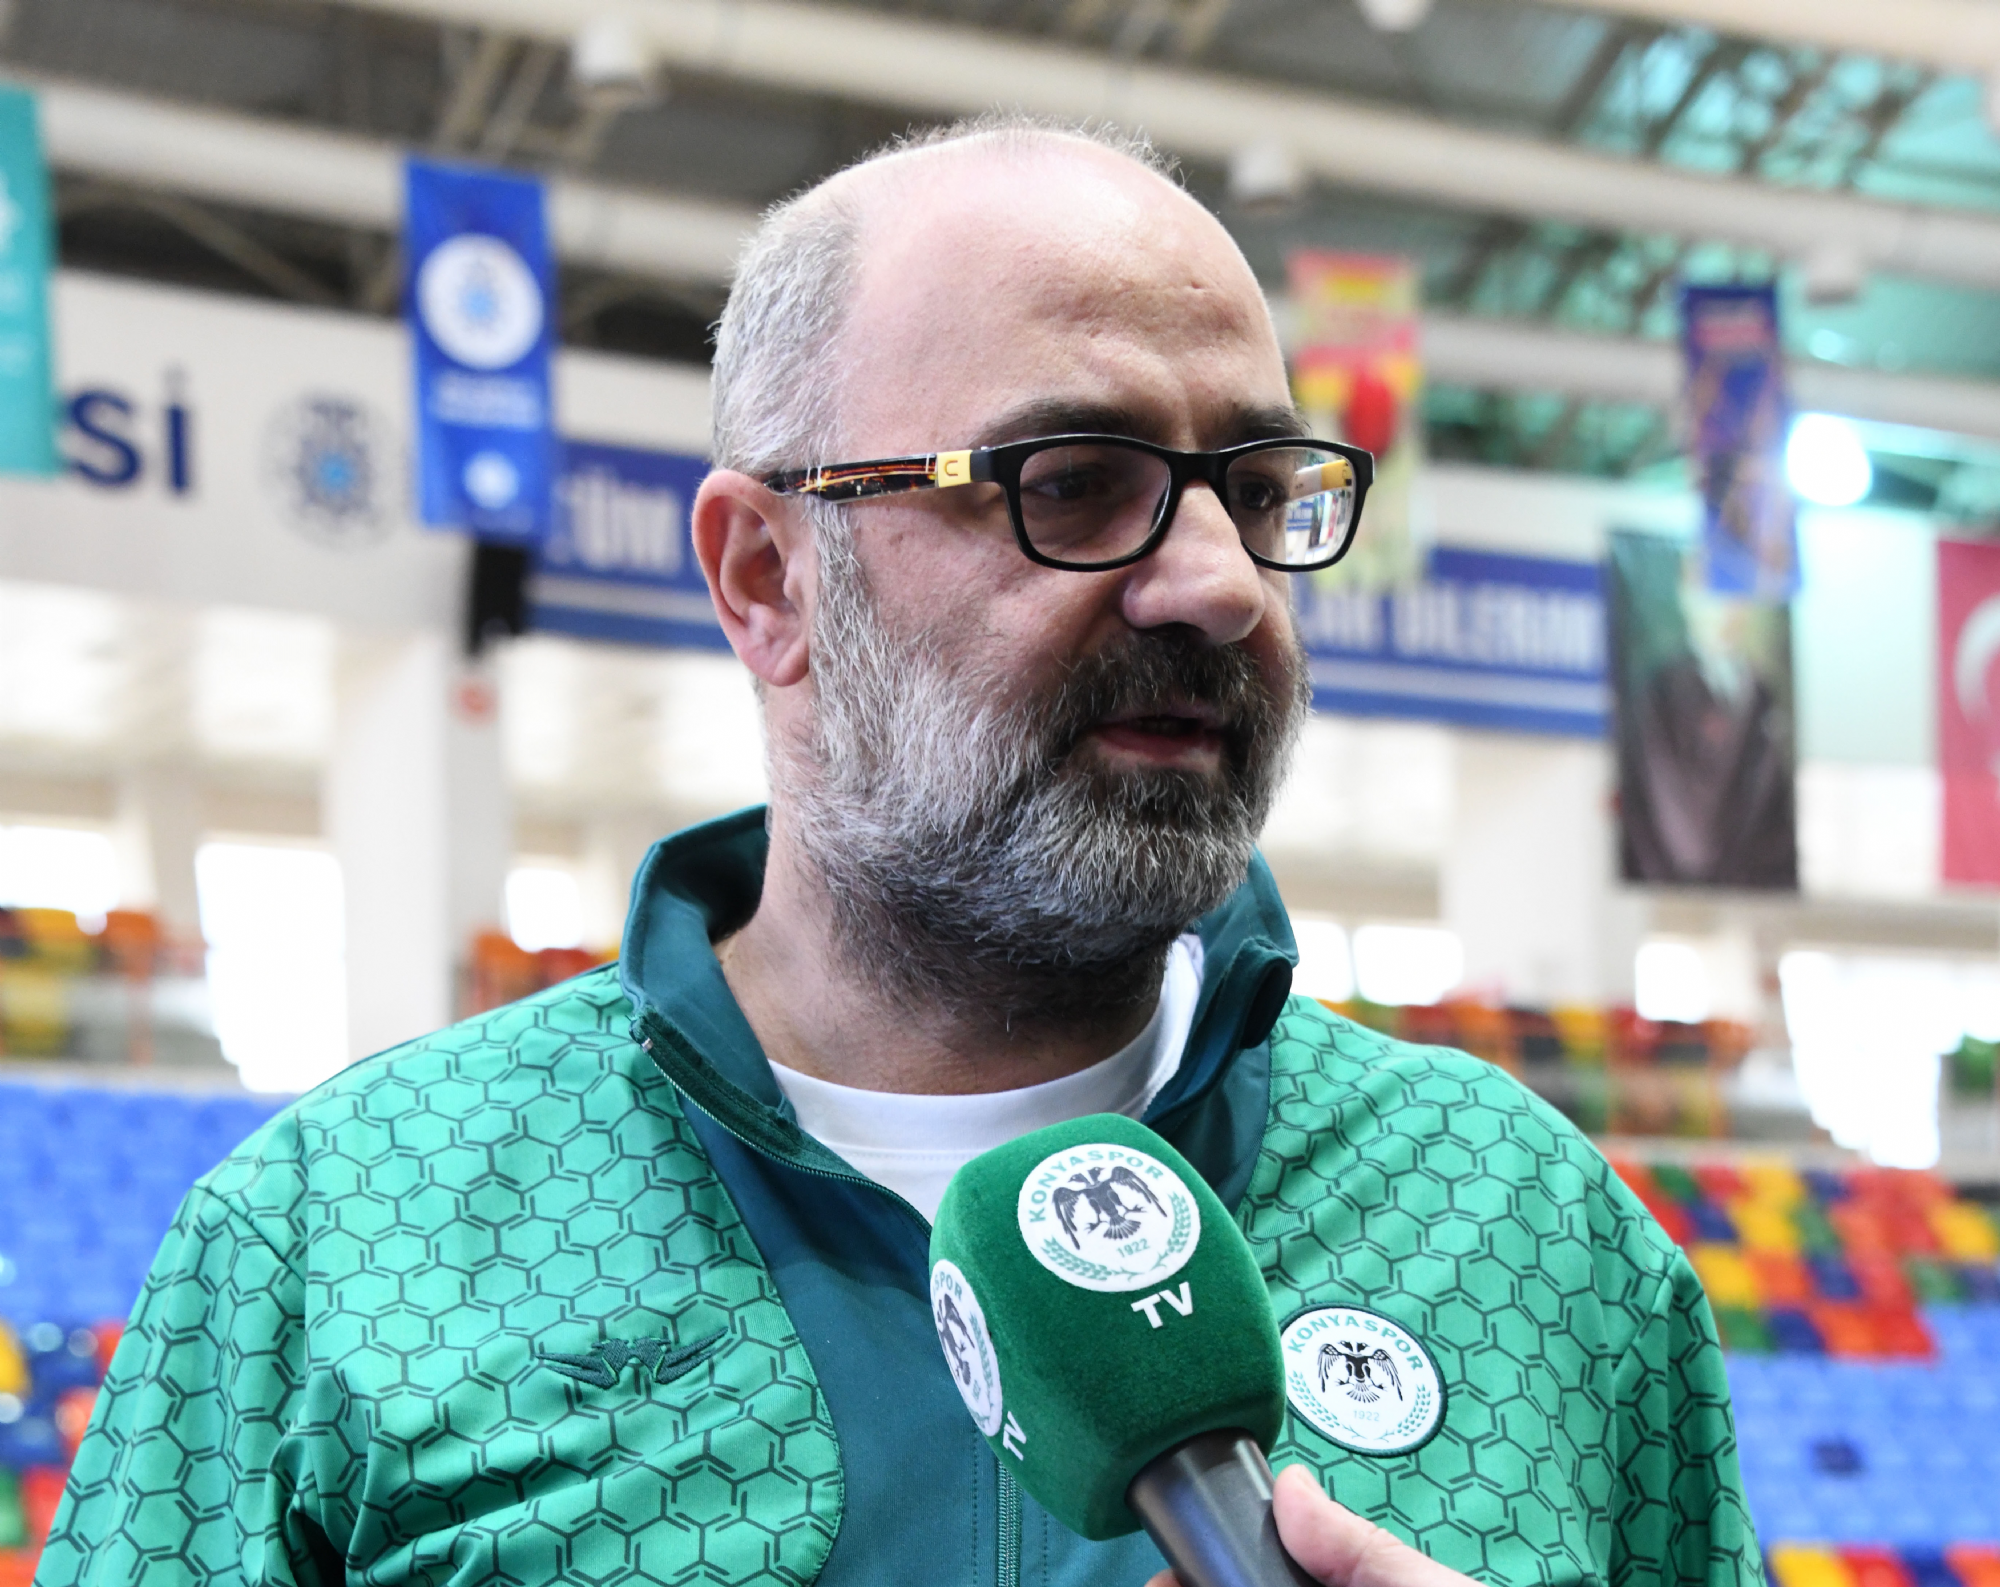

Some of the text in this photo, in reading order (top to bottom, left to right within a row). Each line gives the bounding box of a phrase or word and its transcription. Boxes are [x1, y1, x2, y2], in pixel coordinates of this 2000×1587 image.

[1029, 1150, 1163, 1223] KONYASPOR
[1115, 1238, 1150, 1258] 1922
[933, 1271, 962, 1302] SPOR
[1130, 1281, 1194, 1329] TV
[1287, 1315, 1424, 1370] KONYASPOR
[1002, 1410, 1027, 1461] TV
[1352, 1409, 1381, 1423] 1922
